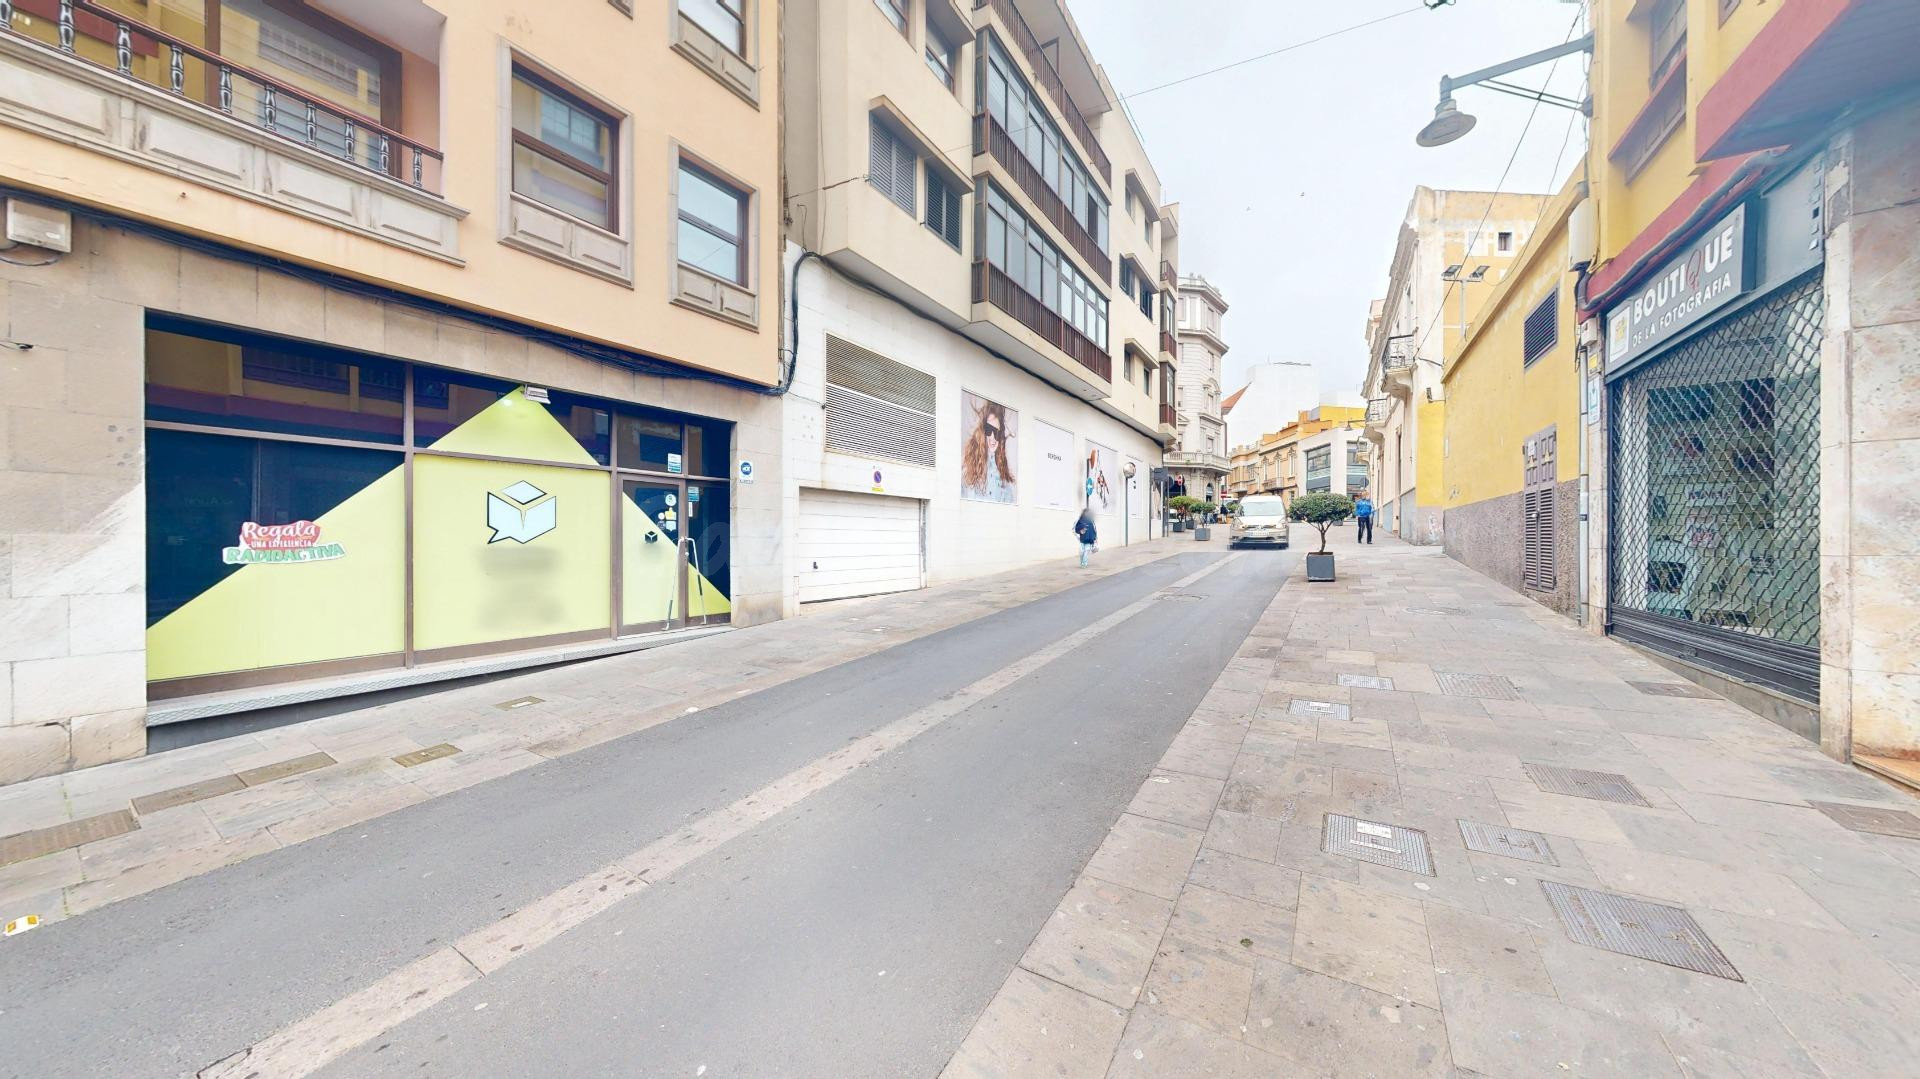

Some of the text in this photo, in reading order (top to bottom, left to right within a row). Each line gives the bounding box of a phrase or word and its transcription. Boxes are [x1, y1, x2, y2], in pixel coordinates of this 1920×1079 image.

[1634, 225, 1734, 323] BOUTIQUE
[1632, 272, 1731, 347] DE LA FOTOGRAFIA
[243, 521, 315, 541] Regala
[226, 544, 344, 561] RADIOACTIVA
[251, 540, 266, 548] UNA
